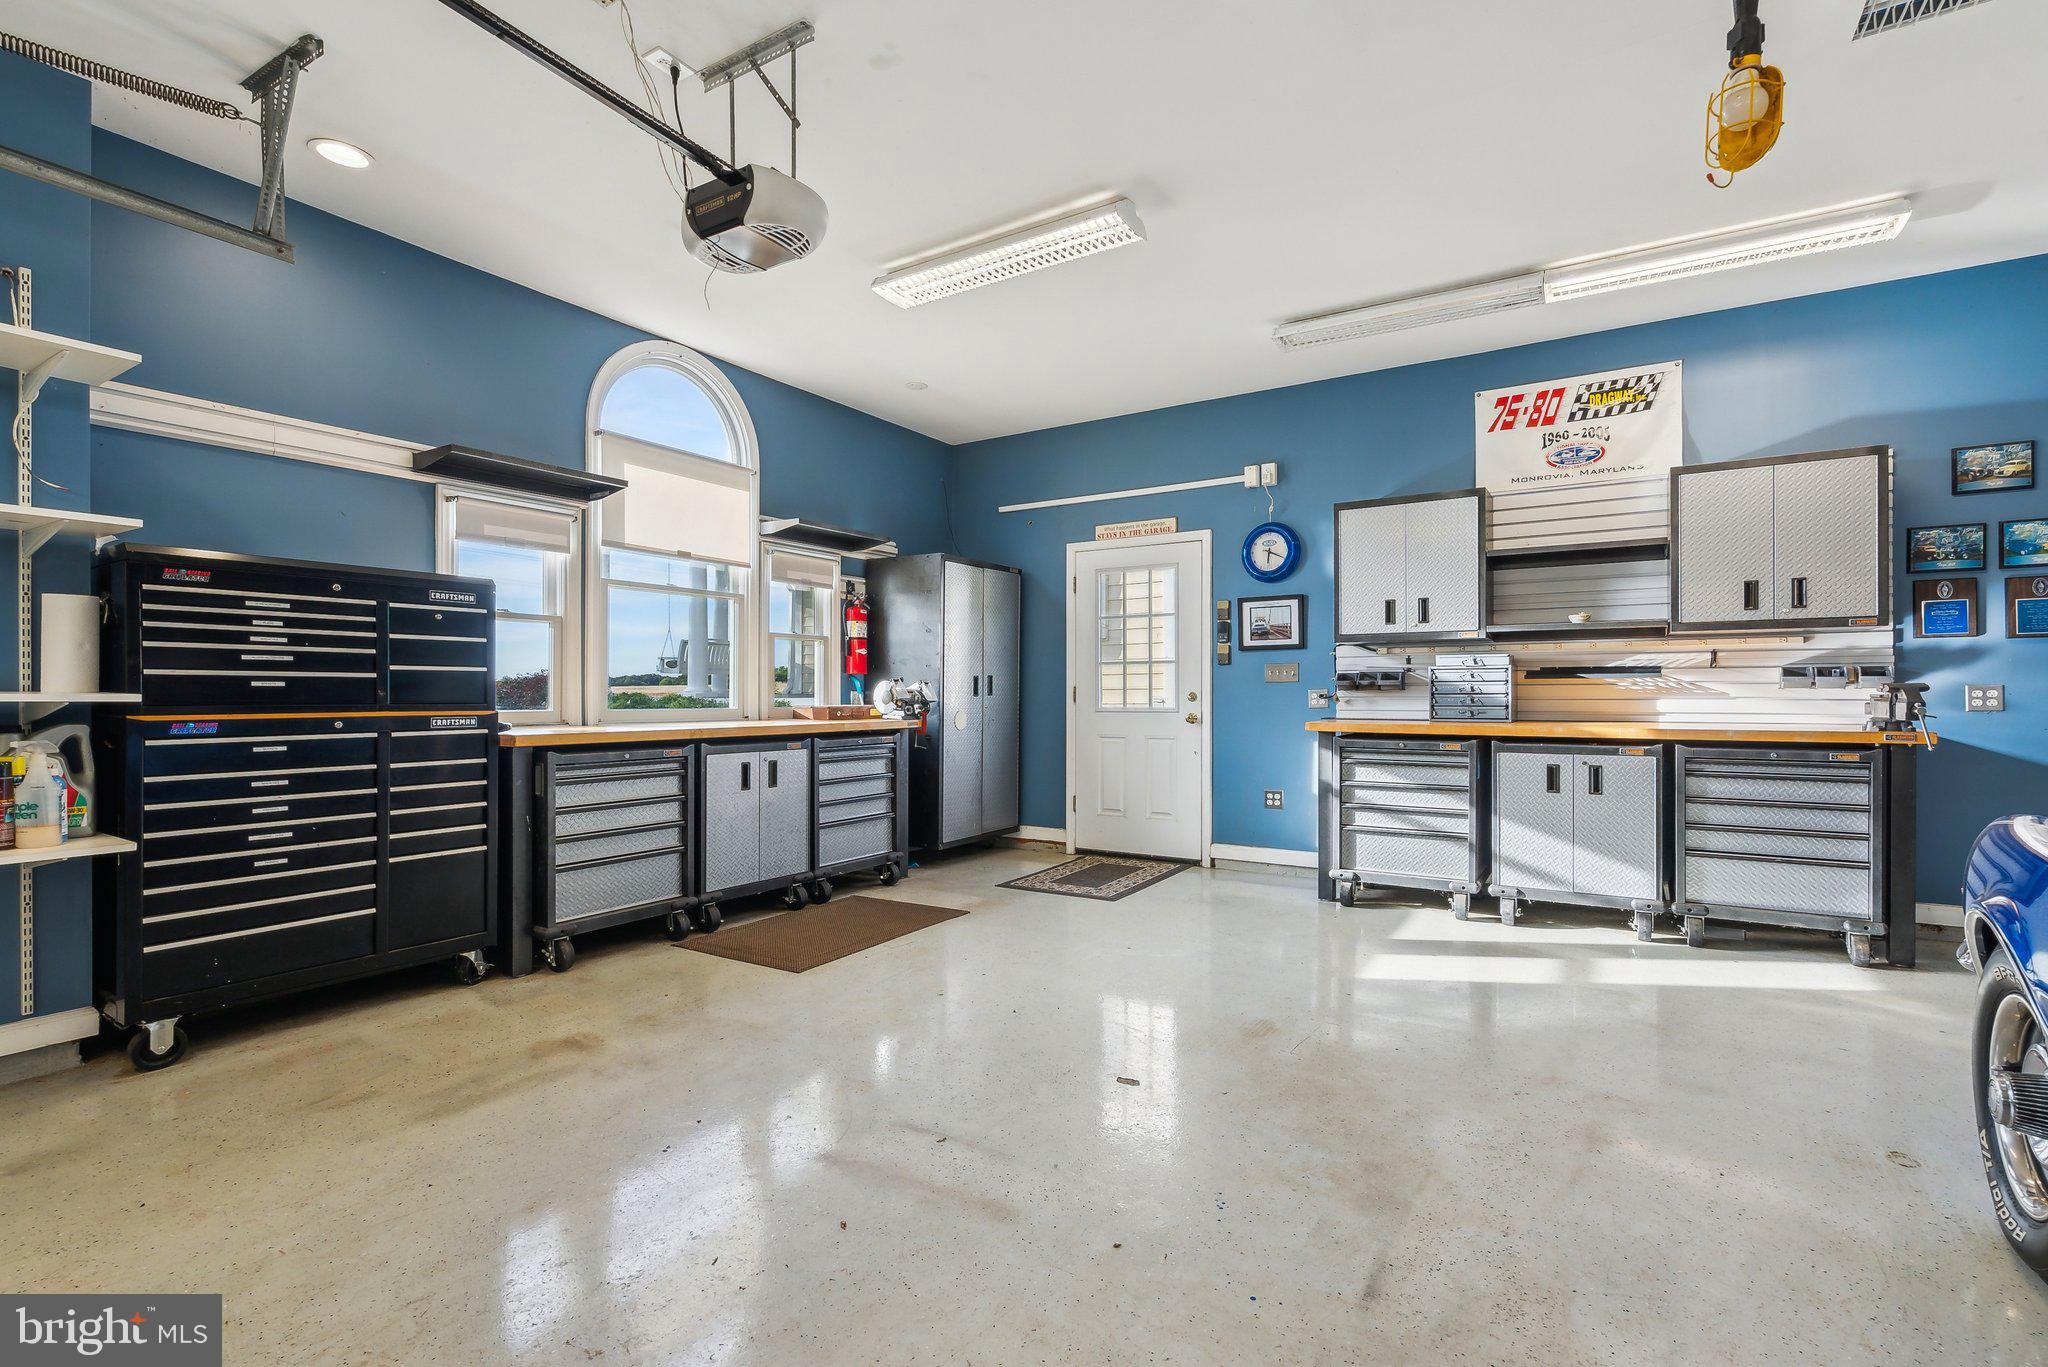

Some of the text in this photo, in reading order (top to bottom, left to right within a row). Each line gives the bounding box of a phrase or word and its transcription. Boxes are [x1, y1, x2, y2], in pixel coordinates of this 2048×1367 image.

[1542, 430, 1570, 449] 1960
[1511, 465, 1646, 484] MONROVIA, MARYLAND
[1097, 531, 1117, 540] STAYS
[1120, 530, 1127, 538] IN
[1129, 529, 1142, 537] THE
[431, 591, 475, 602] CRAFTSMAN
[432, 718, 476, 727] CRAFTSMAN
[15, 802, 39, 812] mple
[1979, 1128, 2027, 1242] Radial T/A
